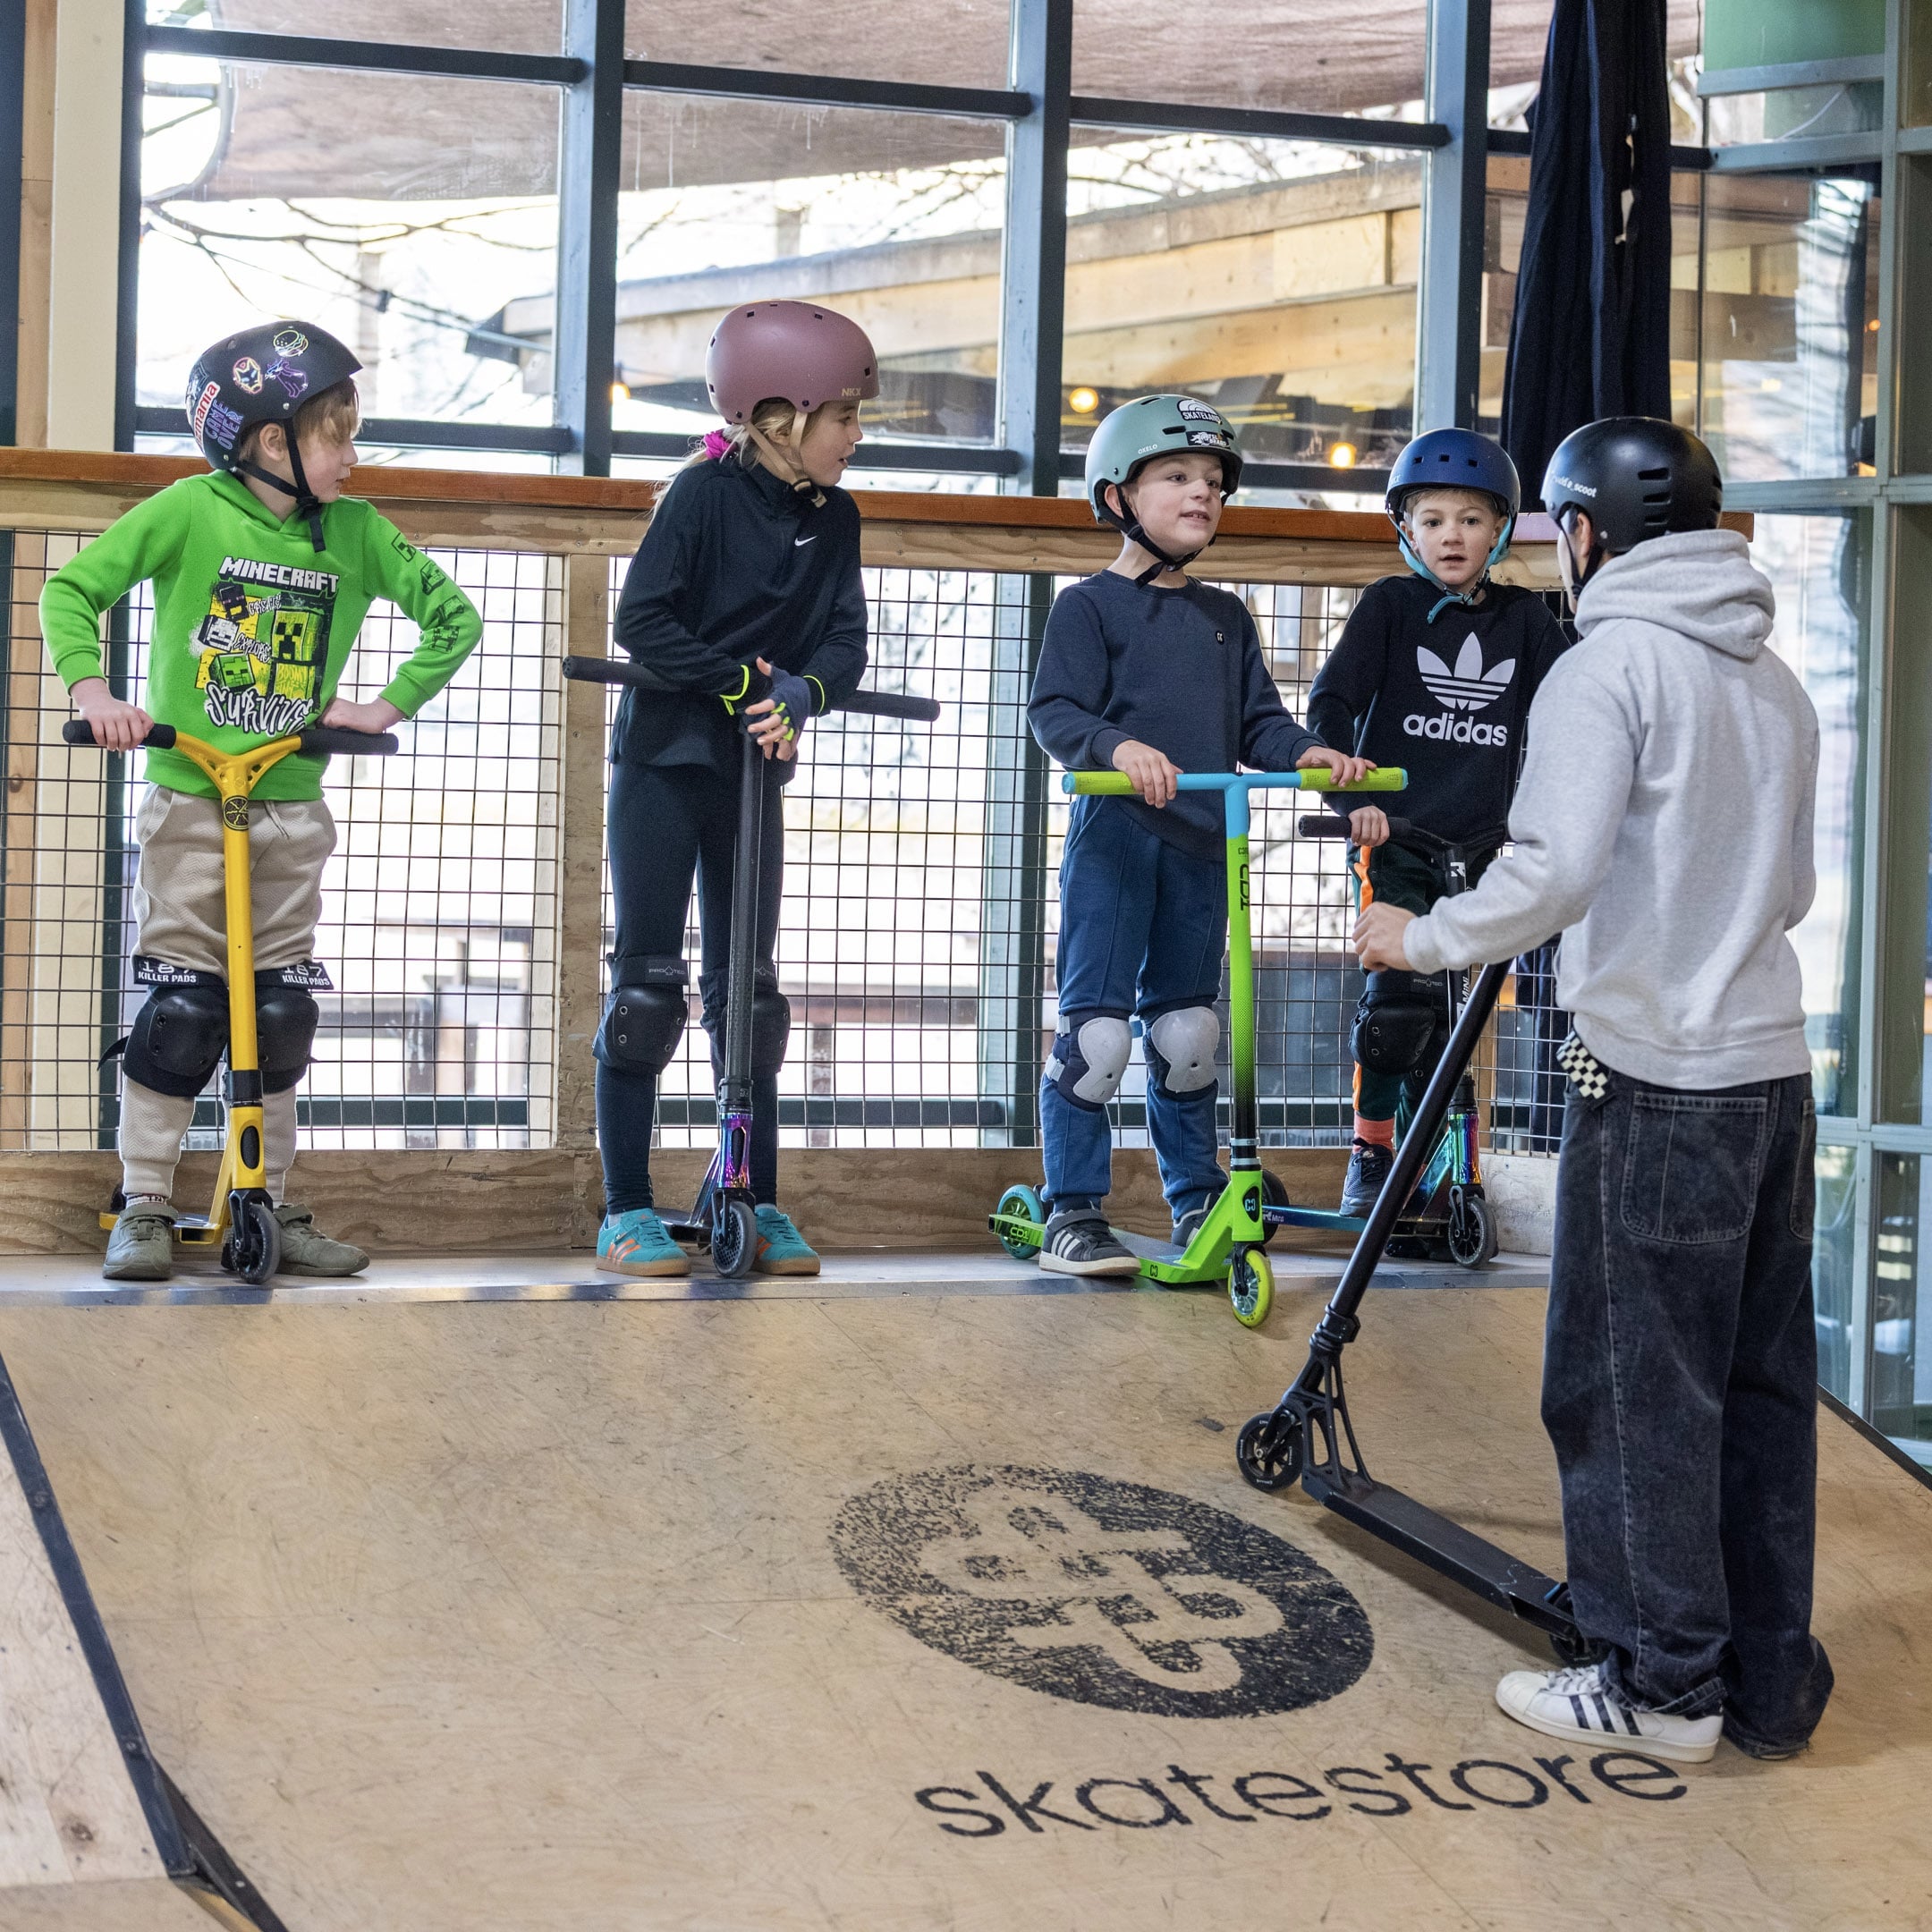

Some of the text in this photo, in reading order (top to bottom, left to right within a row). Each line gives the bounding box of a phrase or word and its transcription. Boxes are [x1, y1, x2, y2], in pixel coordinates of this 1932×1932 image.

[841, 386, 862, 397] NKX
[205, 399, 229, 439] GAME
[217, 411, 244, 450] OVER
[1138, 444, 1158, 454] OXELO
[218, 555, 340, 594] MINECRAFT
[205, 682, 314, 735] SURVIVE
[1402, 712, 1508, 747] adidas
[138, 970, 198, 983] KILLER PADS
[282, 974, 331, 987] KILLER PADS
[914, 1752, 1689, 1838] skatestore
